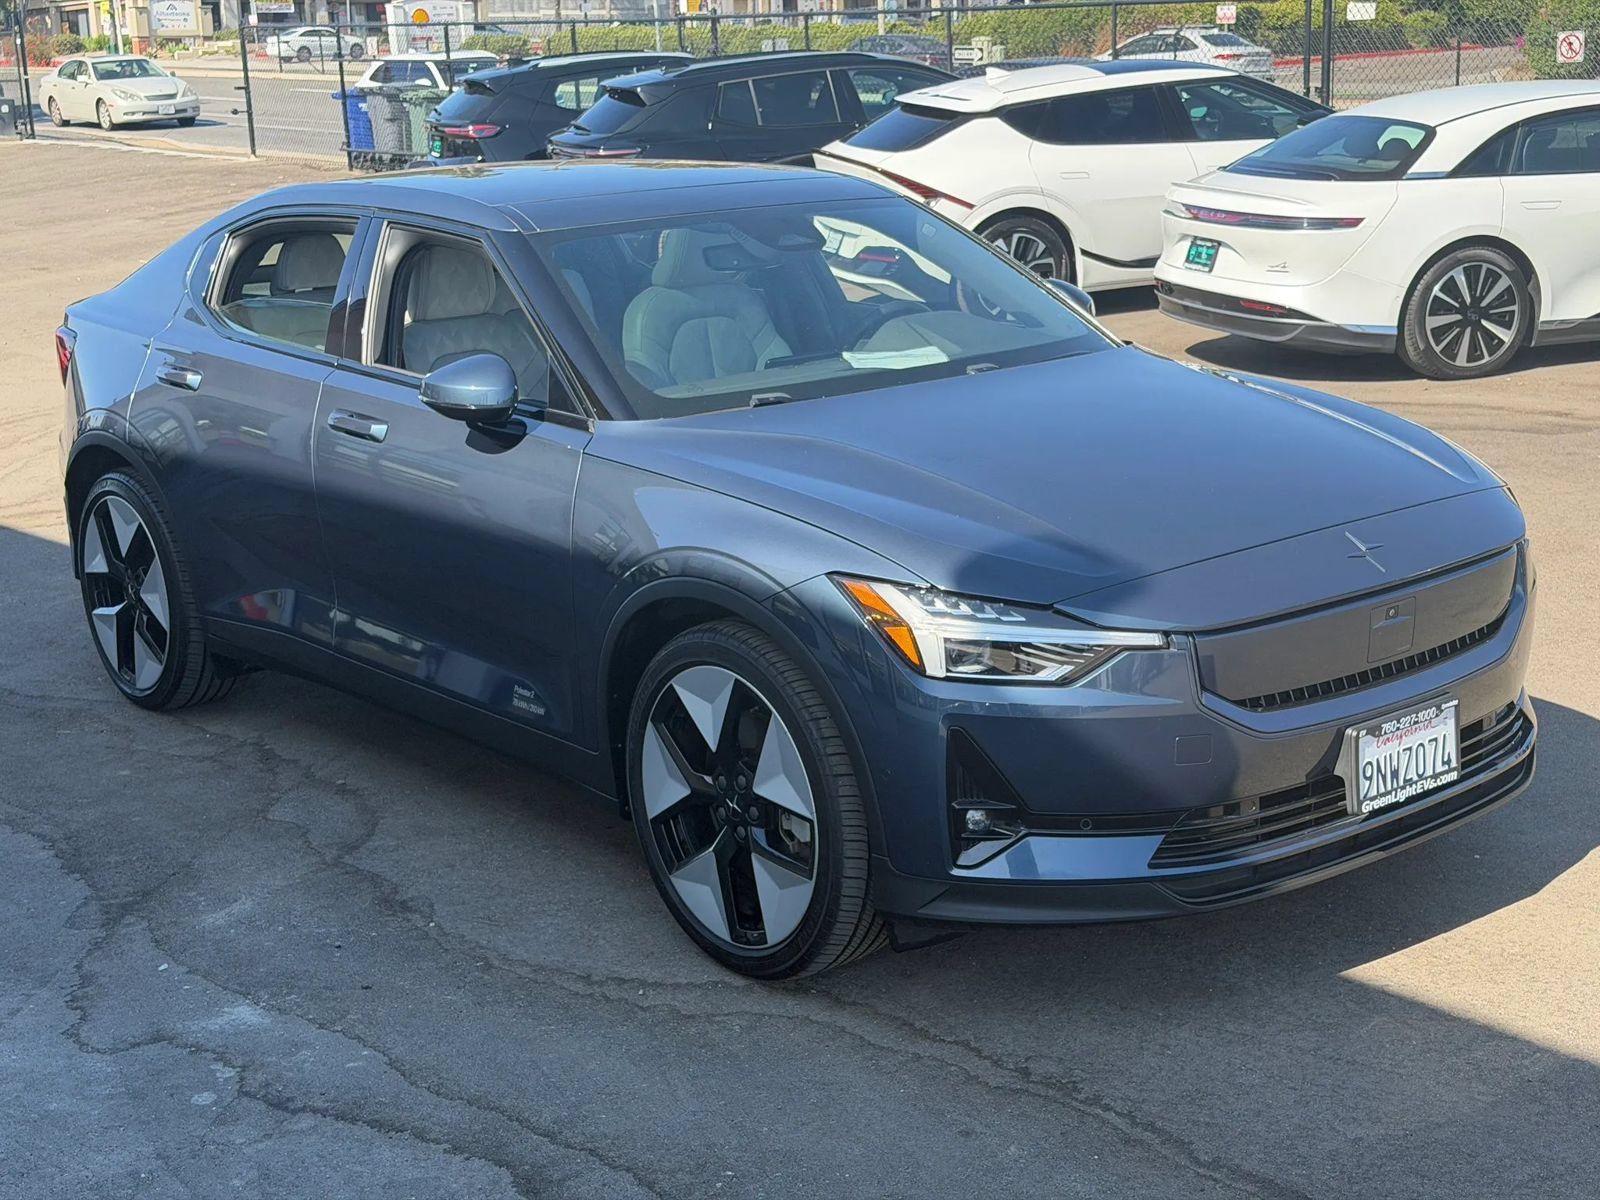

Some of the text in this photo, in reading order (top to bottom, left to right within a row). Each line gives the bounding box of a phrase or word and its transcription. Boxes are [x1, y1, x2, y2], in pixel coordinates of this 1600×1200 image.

[1376, 720, 1437, 749] California
[1381, 707, 1437, 735] 760-227-1000
[1362, 732, 1452, 800] 9NWZ074
[1361, 770, 1458, 813] GreenLightEVs.com
